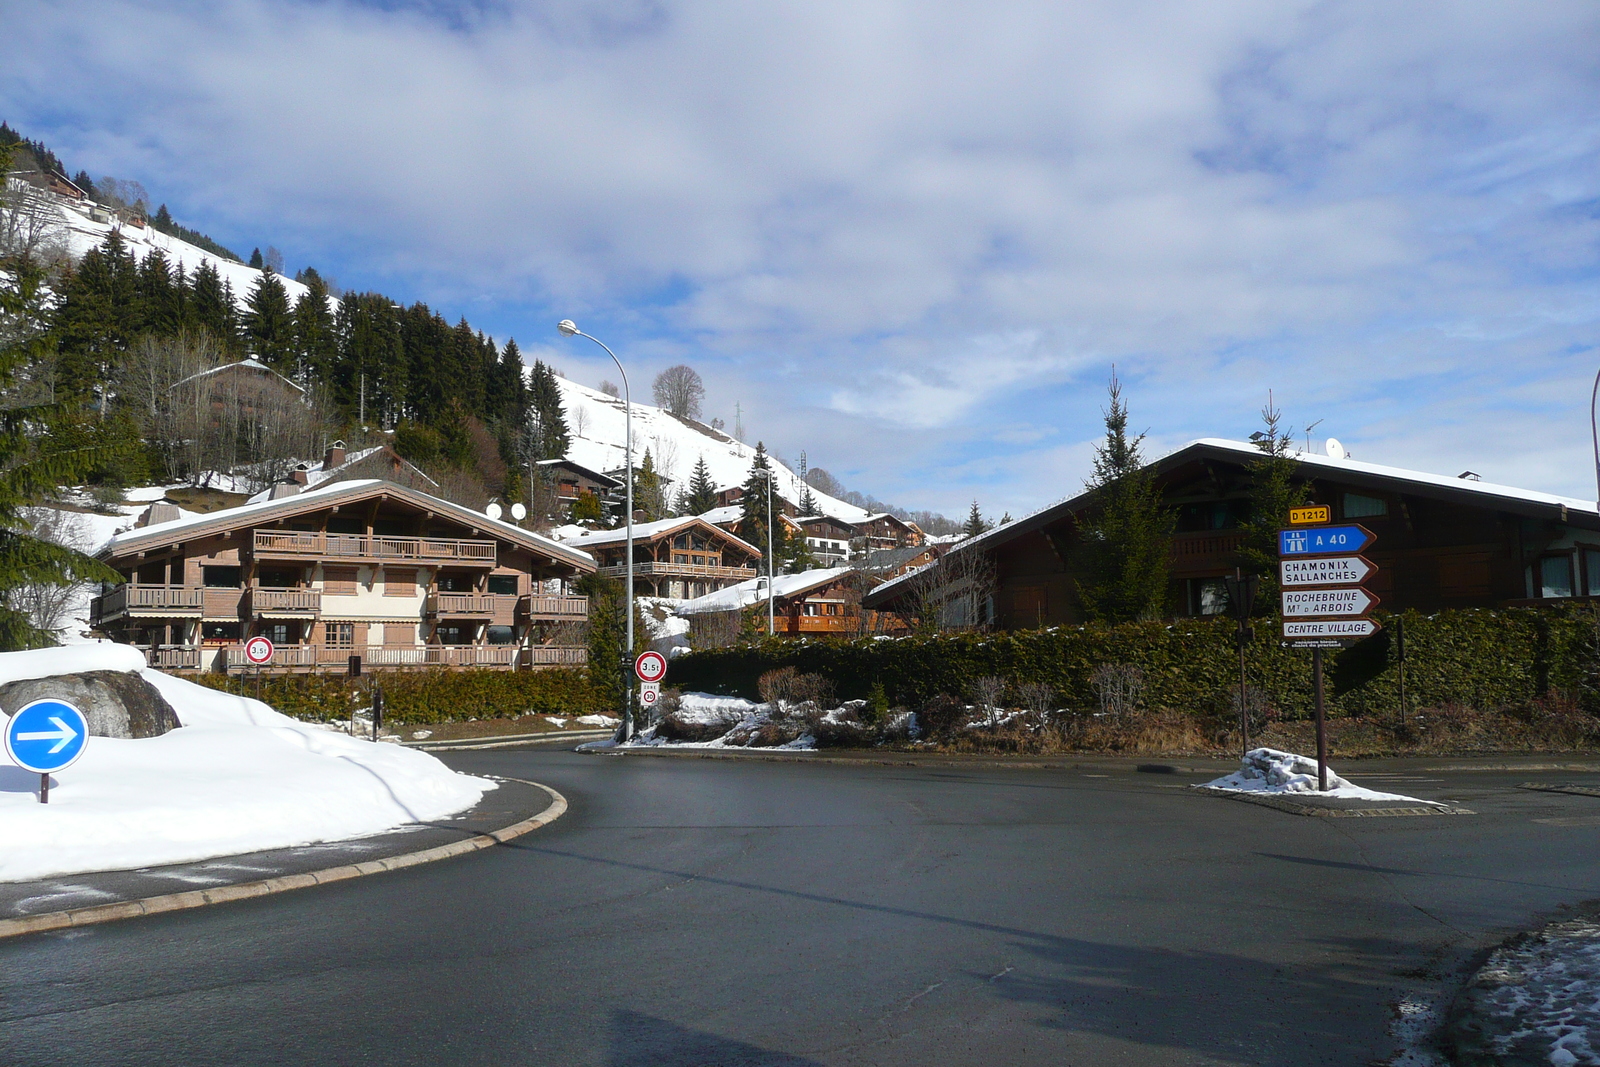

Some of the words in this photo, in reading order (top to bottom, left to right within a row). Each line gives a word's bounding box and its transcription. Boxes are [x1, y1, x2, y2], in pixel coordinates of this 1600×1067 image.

[1292, 512, 1299, 521] D
[1301, 510, 1326, 520] 1212
[1315, 535, 1324, 546] A
[1329, 534, 1347, 545] 40
[1285, 561, 1349, 572] CHAMONIX
[1285, 571, 1357, 582] SALLANCHES
[1286, 592, 1358, 603] ROCHEBRUNE
[1312, 603, 1354, 613] ARBOIS
[1287, 624, 1324, 634] CENTRE
[1327, 623, 1367, 633] VILLAGE
[642, 662, 659, 671] 3.5t
